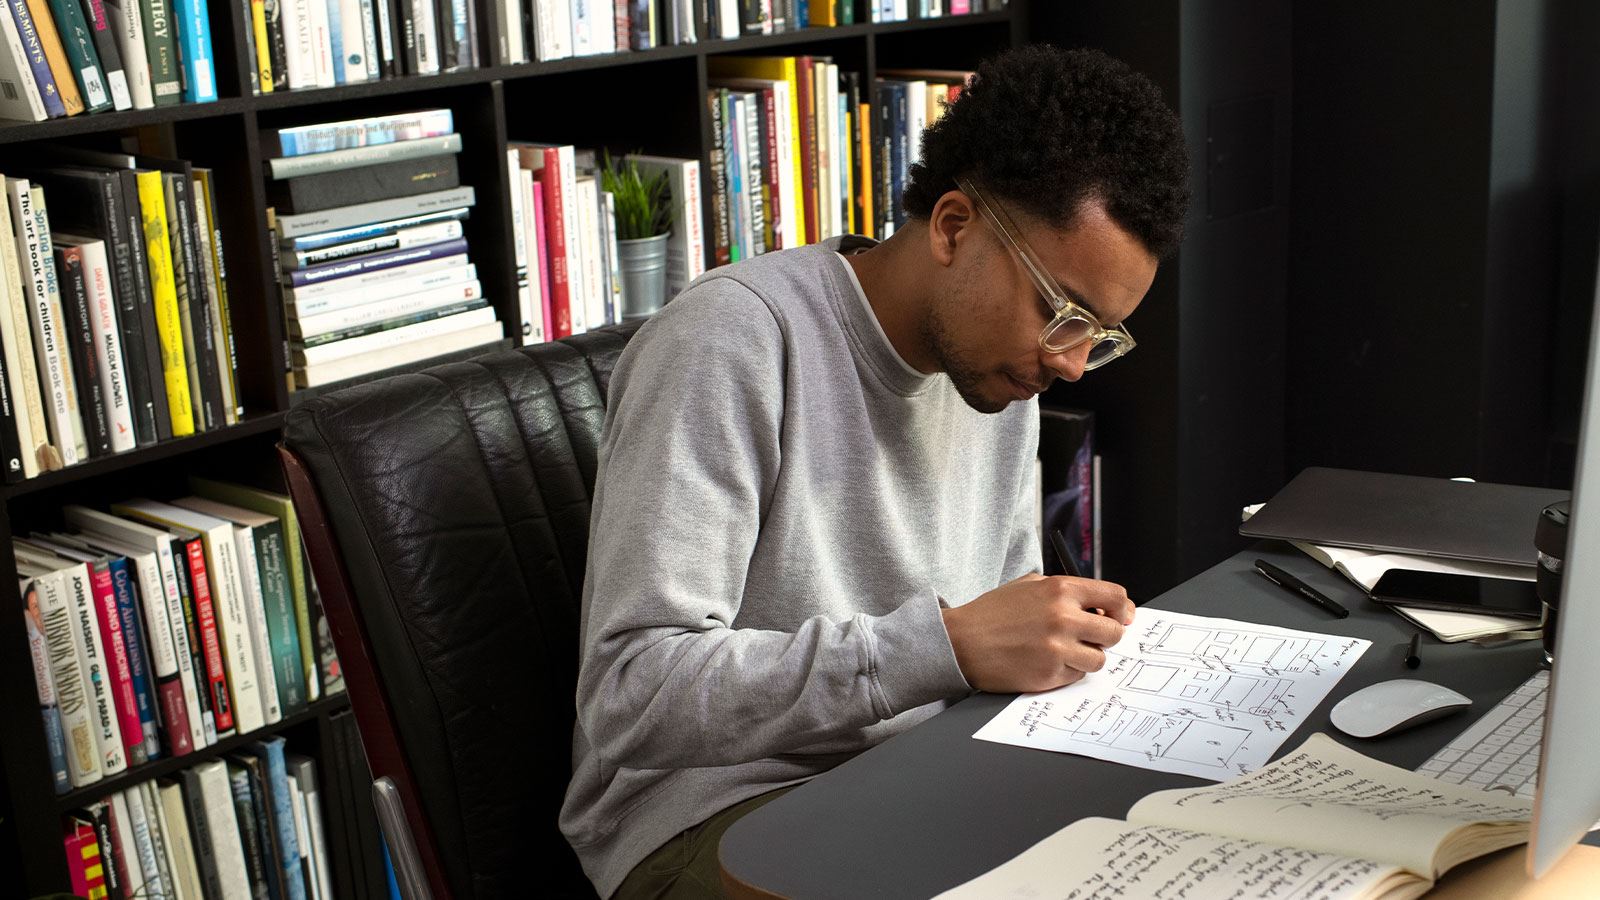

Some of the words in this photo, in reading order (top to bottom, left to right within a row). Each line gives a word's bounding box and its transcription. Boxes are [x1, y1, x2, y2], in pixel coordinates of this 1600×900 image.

[19, 191, 31, 215] The
[714, 163, 730, 247] PHOTOGRAPHS
[24, 218, 35, 240] art
[31, 207, 54, 253] Spring
[28, 242, 42, 276] book
[41, 255, 61, 294] Broke
[34, 279, 45, 298] for
[73, 274, 82, 291] THE
[38, 301, 55, 352] children
[76, 291, 89, 329] ANATOMY
[83, 331, 91, 343] OF
[103, 333, 117, 370] MALCOLM
[48, 355, 61, 388] Book
[109, 370, 123, 408] GLADWELL
[54, 391, 66, 414] one
[266, 532, 283, 573] Exploring
[71, 575, 86, 607] JOHN
[273, 572, 290, 613] Corporate
[103, 593, 120, 631] BRAND
[78, 609, 97, 659] NAISBITT
[110, 630, 130, 682] MEDICINE
